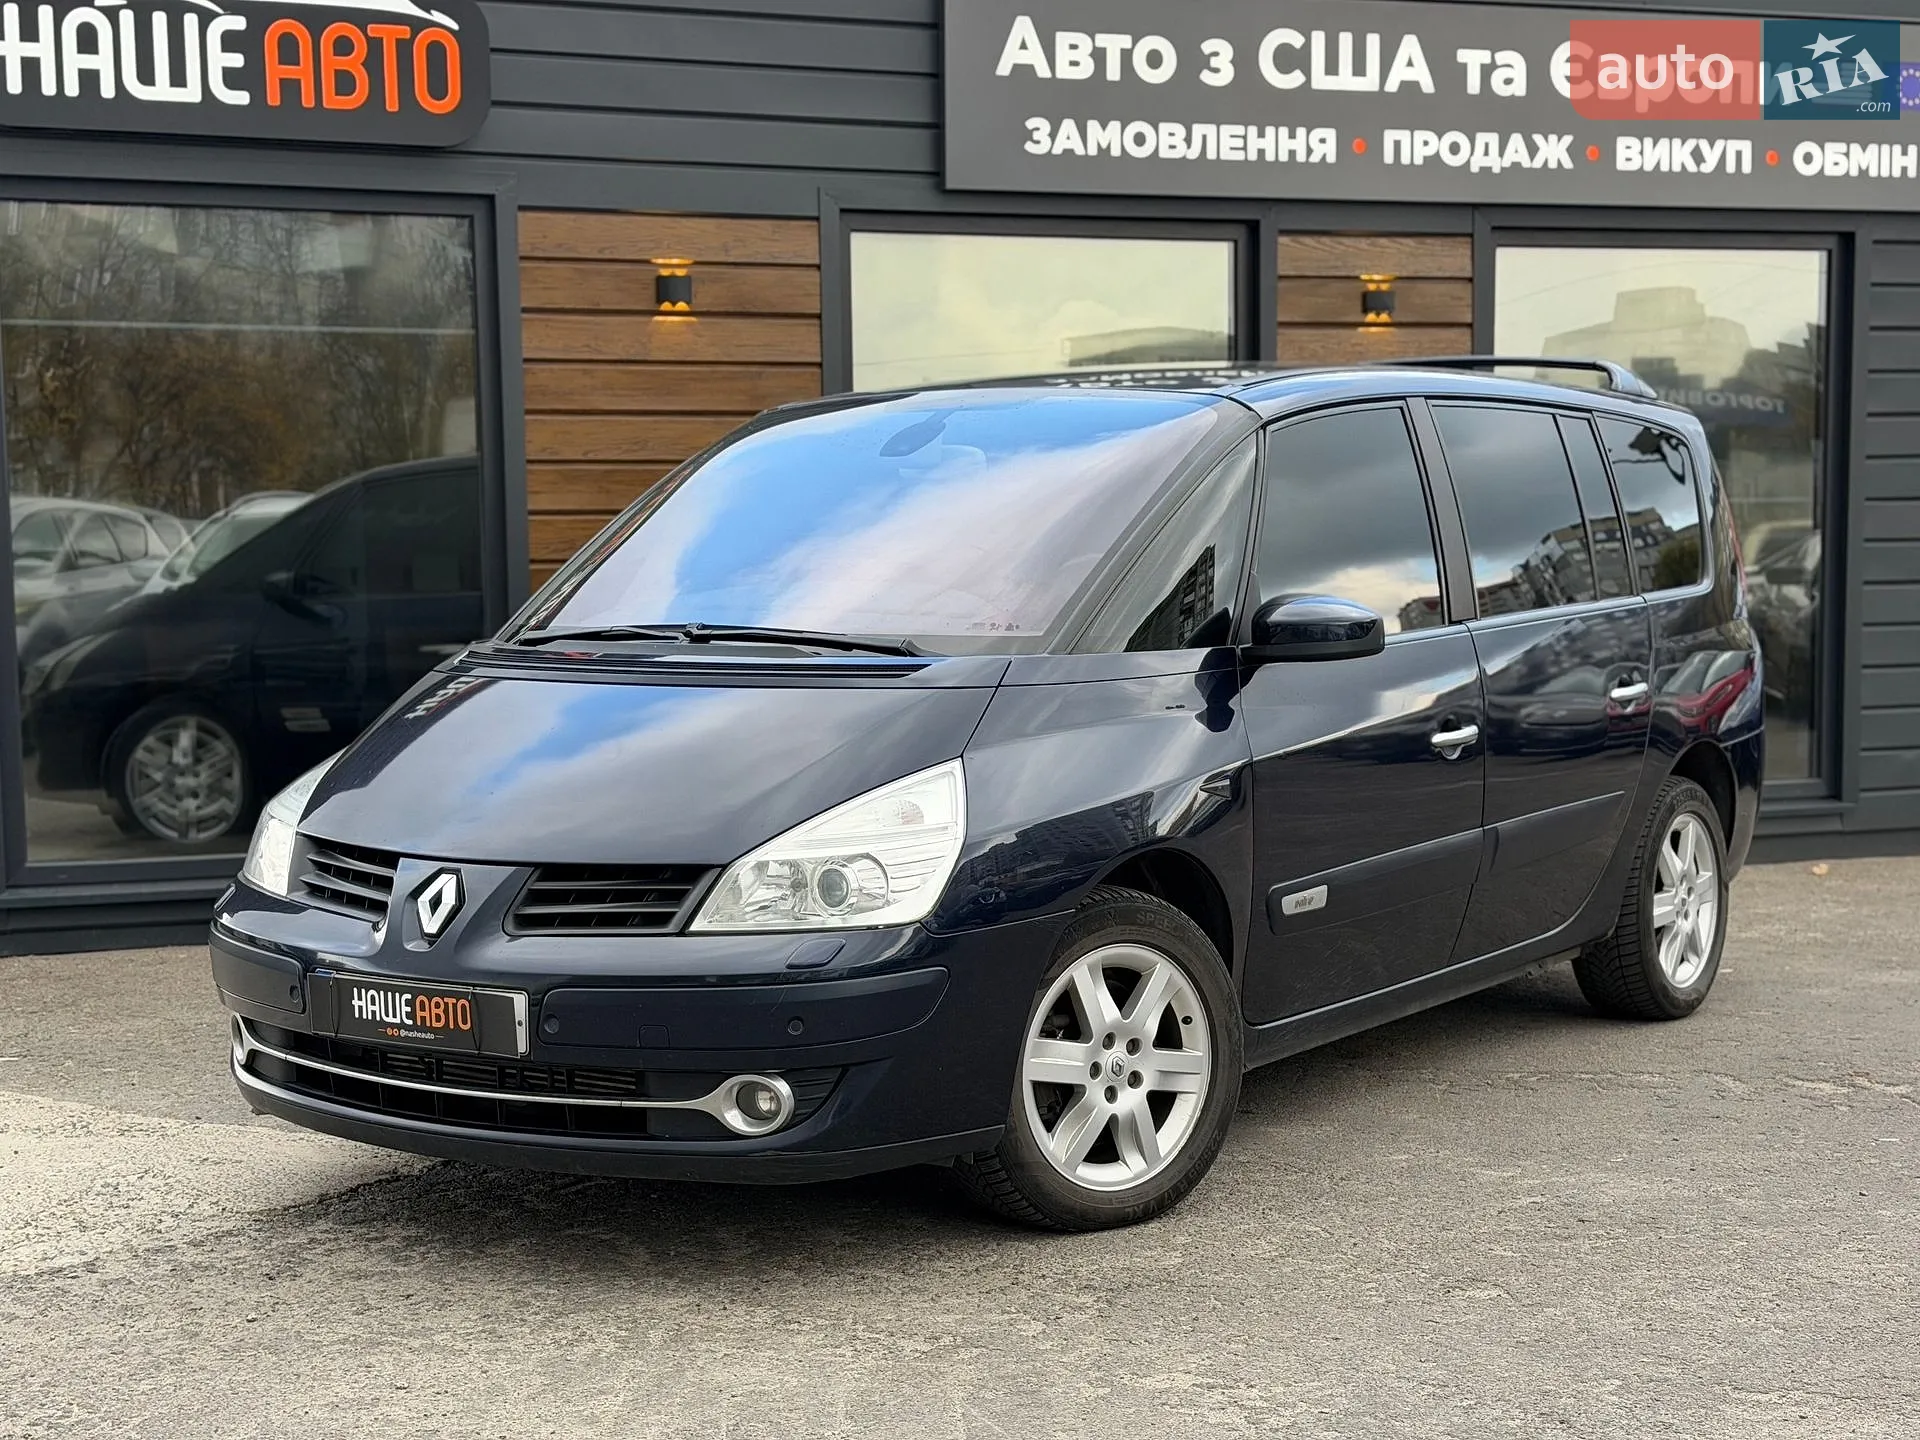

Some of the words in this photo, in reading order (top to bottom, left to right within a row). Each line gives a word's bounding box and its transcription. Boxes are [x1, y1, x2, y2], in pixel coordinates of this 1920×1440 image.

[0, 2, 250, 105] НАШЕ
[264, 18, 462, 115] АВТО
[995, 15, 1178, 84] Авто
[1199, 38, 1235, 87] з
[1258, 27, 1435, 94] США
[1456, 48, 1527, 97] та
[1024, 117, 1337, 163] ЗАМОВЛЕННЯ
[1383, 129, 1574, 174] ПРОДАЖ
[1616, 136, 1753, 174] ВИКУП
[1792, 141, 1918, 178] ОБМІН
[352, 987, 413, 1025] НАШЕ
[415, 994, 472, 1031] АВТО
